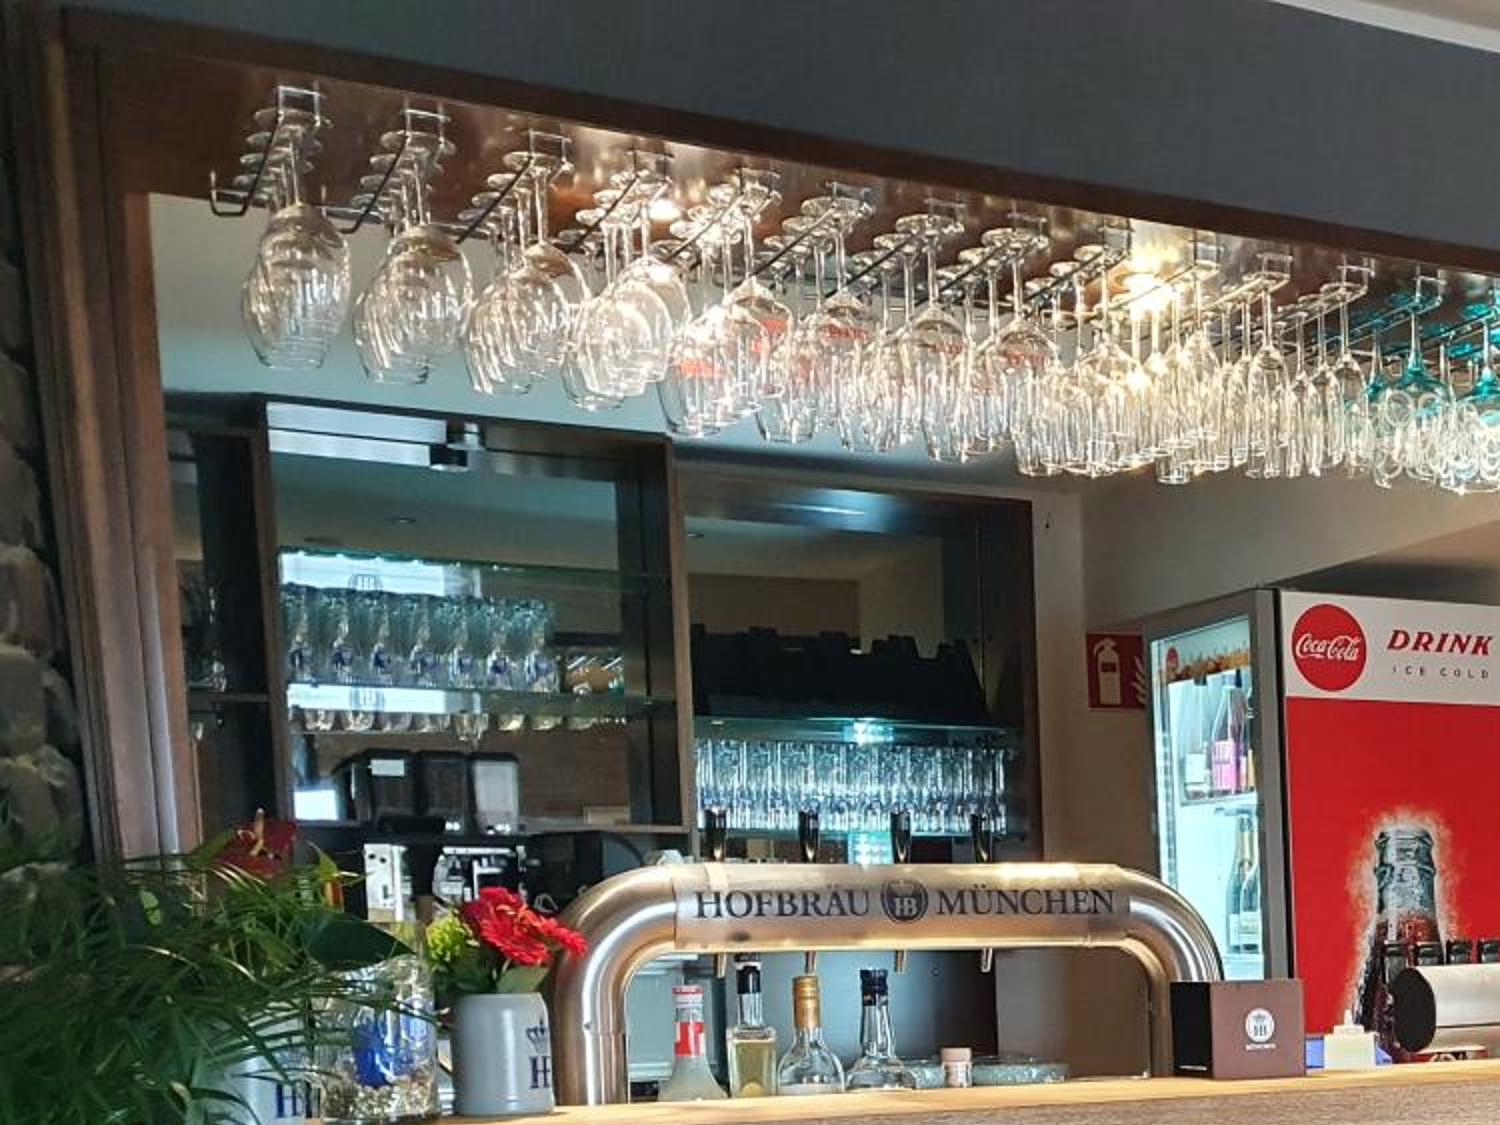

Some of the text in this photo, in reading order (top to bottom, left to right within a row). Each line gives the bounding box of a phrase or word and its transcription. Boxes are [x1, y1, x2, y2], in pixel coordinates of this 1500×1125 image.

[1295, 632, 1361, 661] Coca-Cola
[1387, 629, 1494, 656] DRINK
[1393, 664, 1490, 679] ICE COLD
[696, 884, 870, 919] HOFBRÄU
[935, 883, 1114, 916] MÜNCHEN
